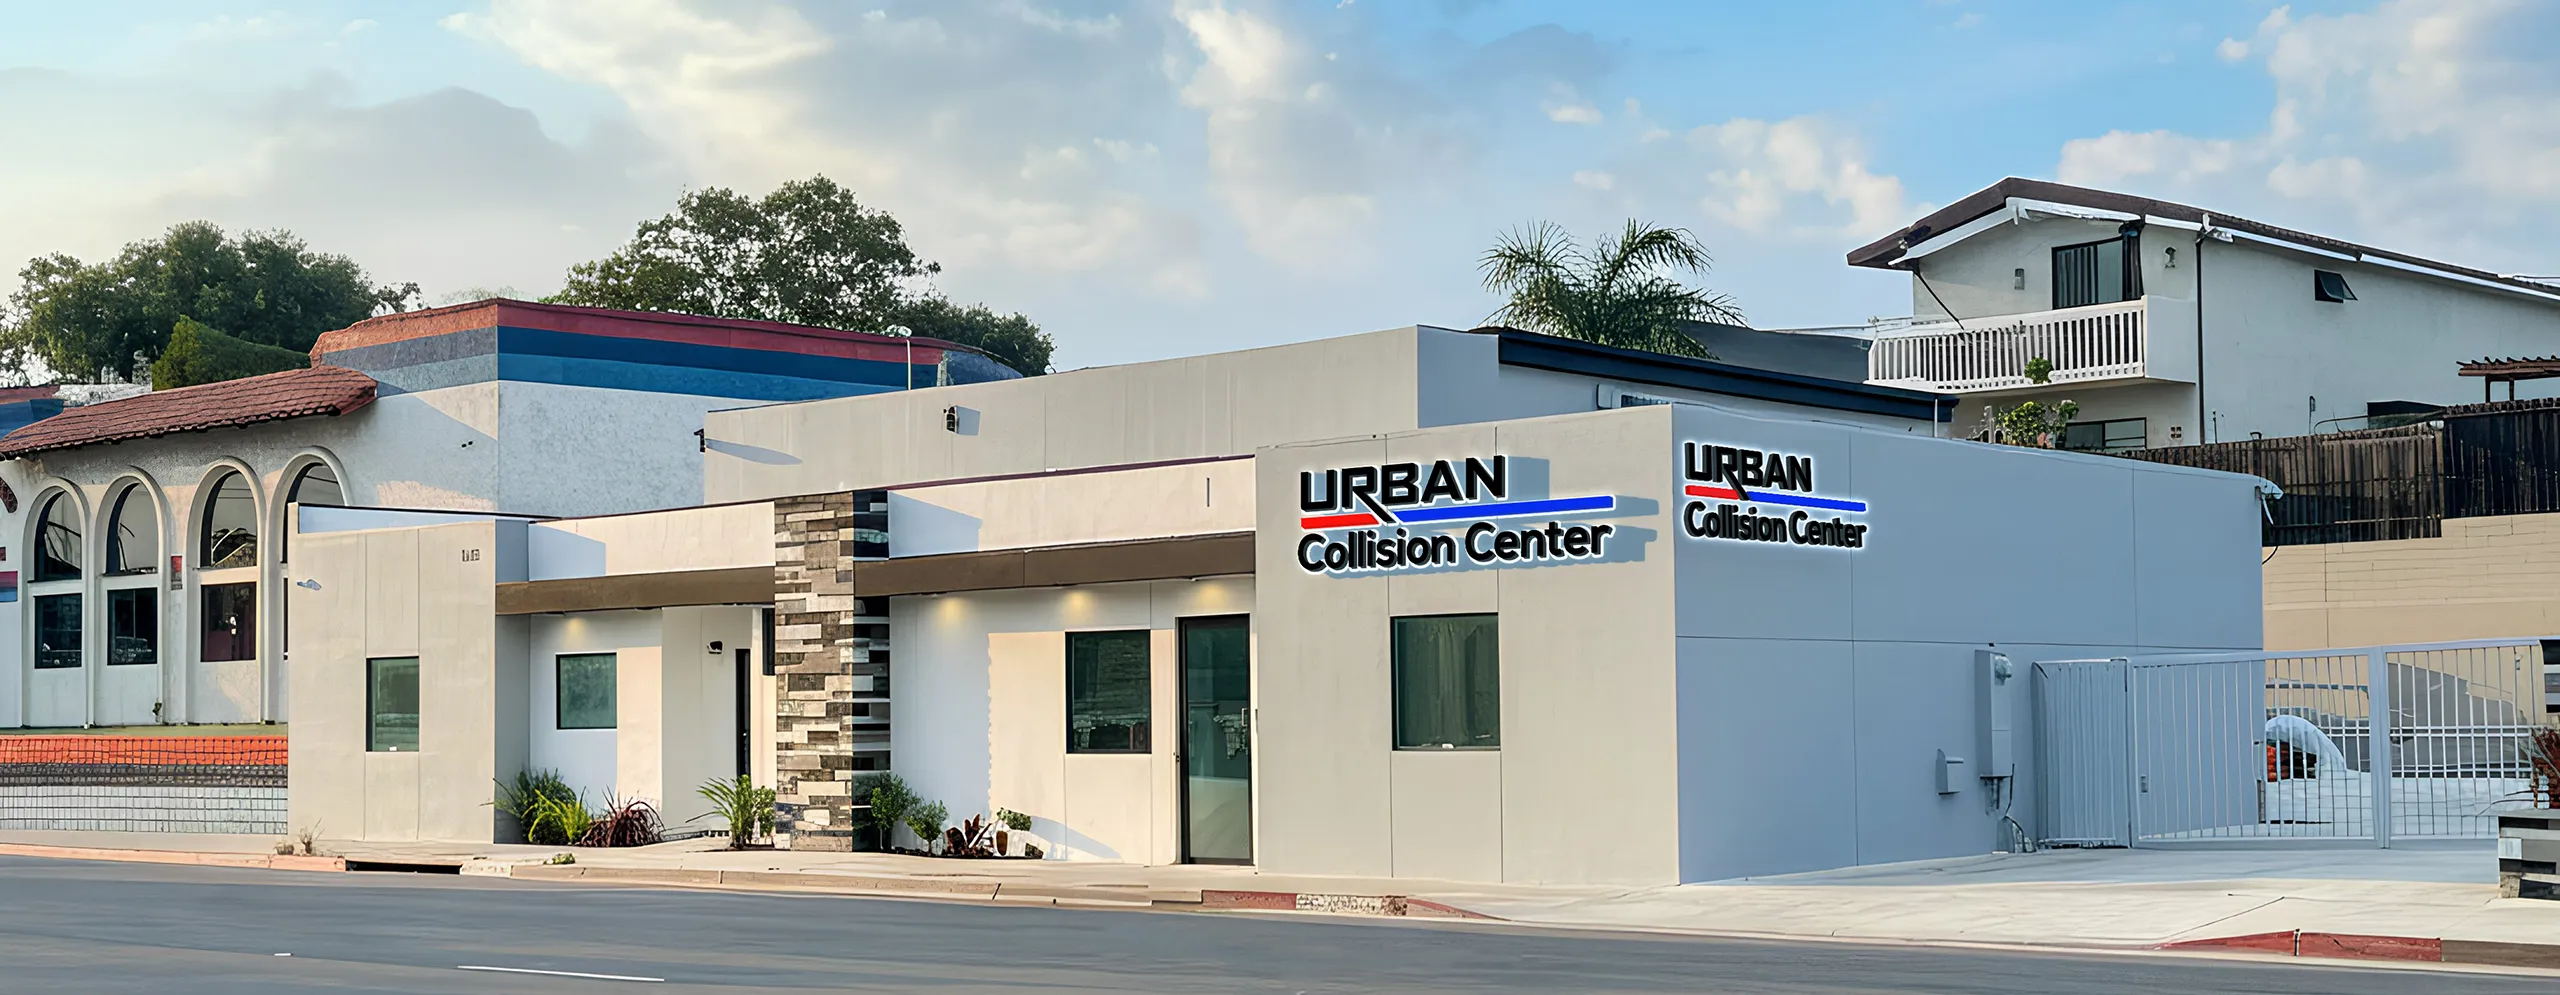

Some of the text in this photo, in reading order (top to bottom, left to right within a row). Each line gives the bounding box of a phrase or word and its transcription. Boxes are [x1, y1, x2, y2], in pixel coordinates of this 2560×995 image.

[1300, 455, 1506, 523] URBAN
[1684, 442, 1812, 500] URBAN
[1299, 521, 1612, 572] Collision Center
[1684, 501, 1867, 548] Collision Center
